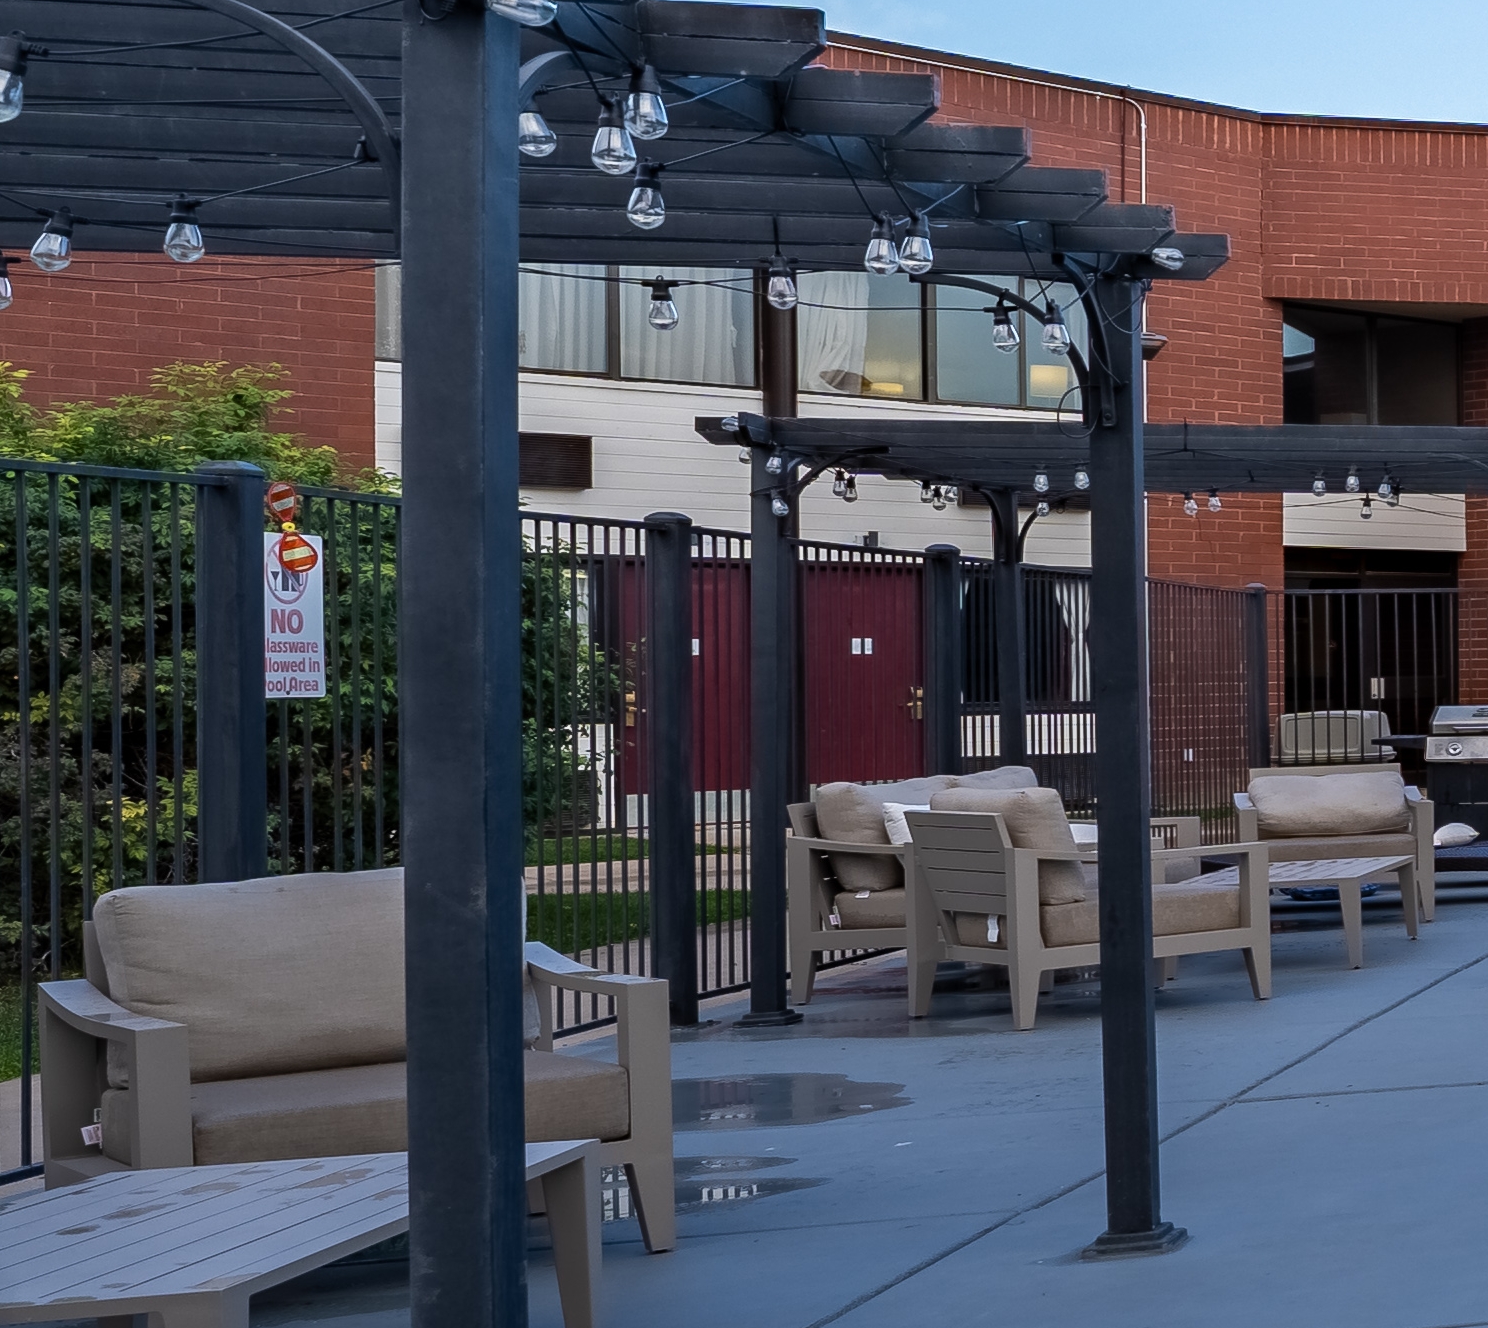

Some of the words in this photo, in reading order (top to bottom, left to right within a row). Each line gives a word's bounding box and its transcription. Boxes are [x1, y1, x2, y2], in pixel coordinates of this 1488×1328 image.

[271, 608, 304, 635] NO
[265, 637, 319, 654] lassware
[264, 657, 306, 673] llowed
[309, 657, 320, 673] in
[265, 676, 287, 692] ool
[289, 676, 319, 692] Area
